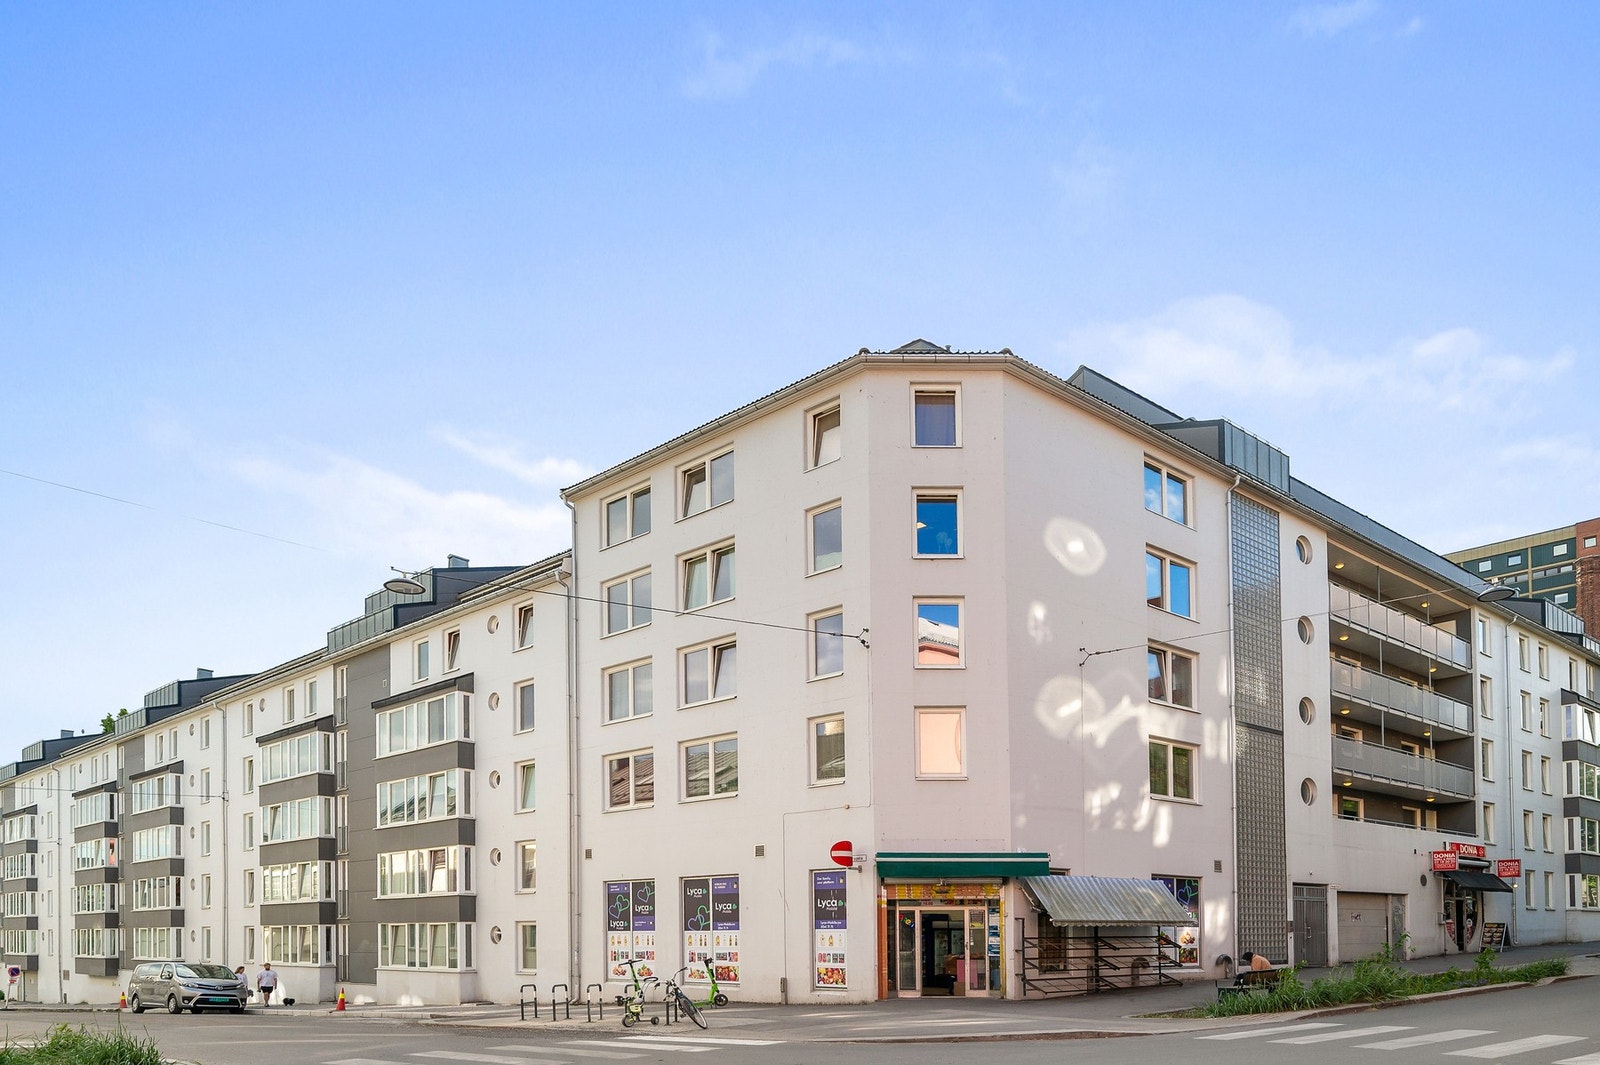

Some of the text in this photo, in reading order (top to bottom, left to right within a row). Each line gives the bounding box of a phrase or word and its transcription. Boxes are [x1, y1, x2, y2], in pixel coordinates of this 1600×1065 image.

[1460, 844, 1477, 854] DONIA
[687, 888, 702, 896] Lyca
[715, 902, 732, 911] Lyca
[818, 898, 837, 908] Lyca
[610, 920, 624, 928] Lyca
